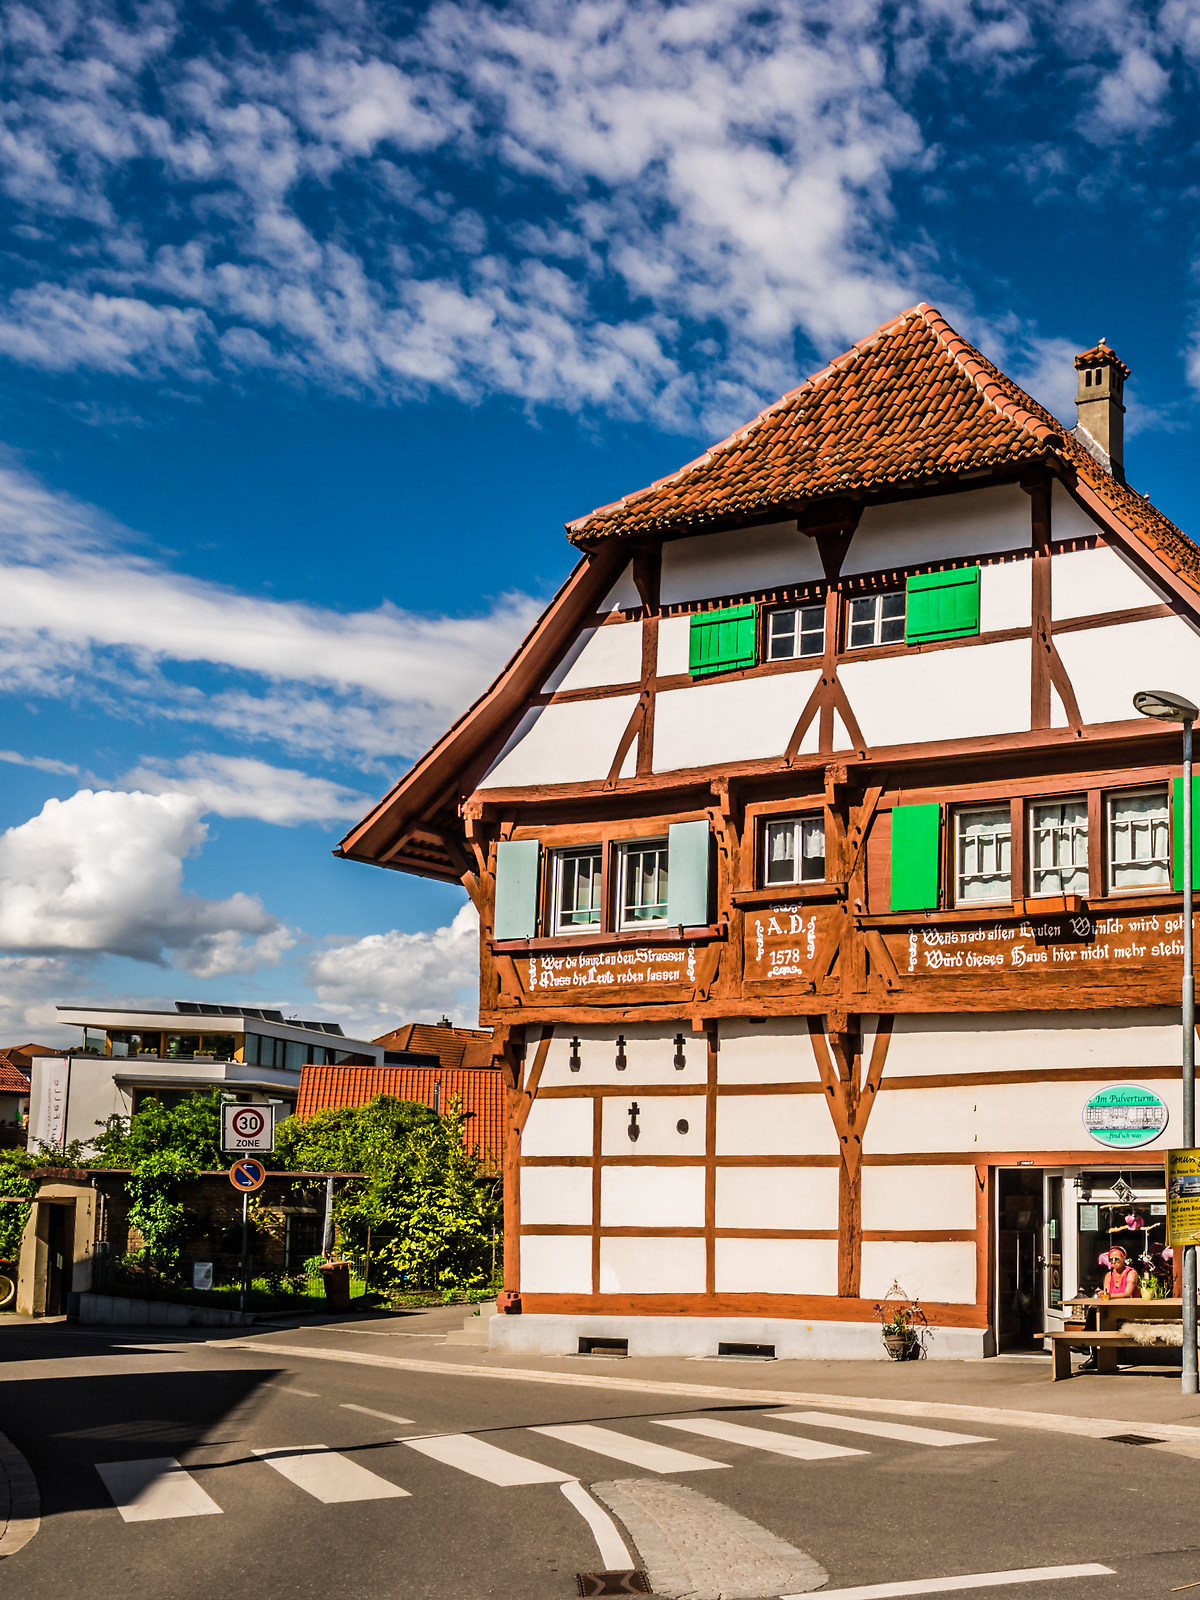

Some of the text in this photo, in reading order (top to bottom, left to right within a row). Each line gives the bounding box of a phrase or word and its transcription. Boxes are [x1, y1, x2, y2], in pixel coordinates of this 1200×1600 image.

[987, 924, 1015, 941] allen
[1019, 920, 1061, 939] Leuten
[540, 953, 565, 970] Wer
[633, 947, 686, 965] Strassen
[769, 948, 800, 966] 1578
[965, 950, 1004, 968] dieses
[1011, 944, 1048, 968] Haus
[1052, 946, 1077, 962] hier
[1080, 943, 1110, 961] nicht
[1113, 942, 1147, 959] mehr
[539, 970, 571, 989] Muss
[572, 970, 587, 986] die
[616, 967, 644, 984] reden
[646, 967, 680, 982] lassen
[1095, 1092, 1154, 1104] Im Pulverturm
[239, 1116, 258, 1130] 30
[236, 1139, 260, 1148] ZONE
